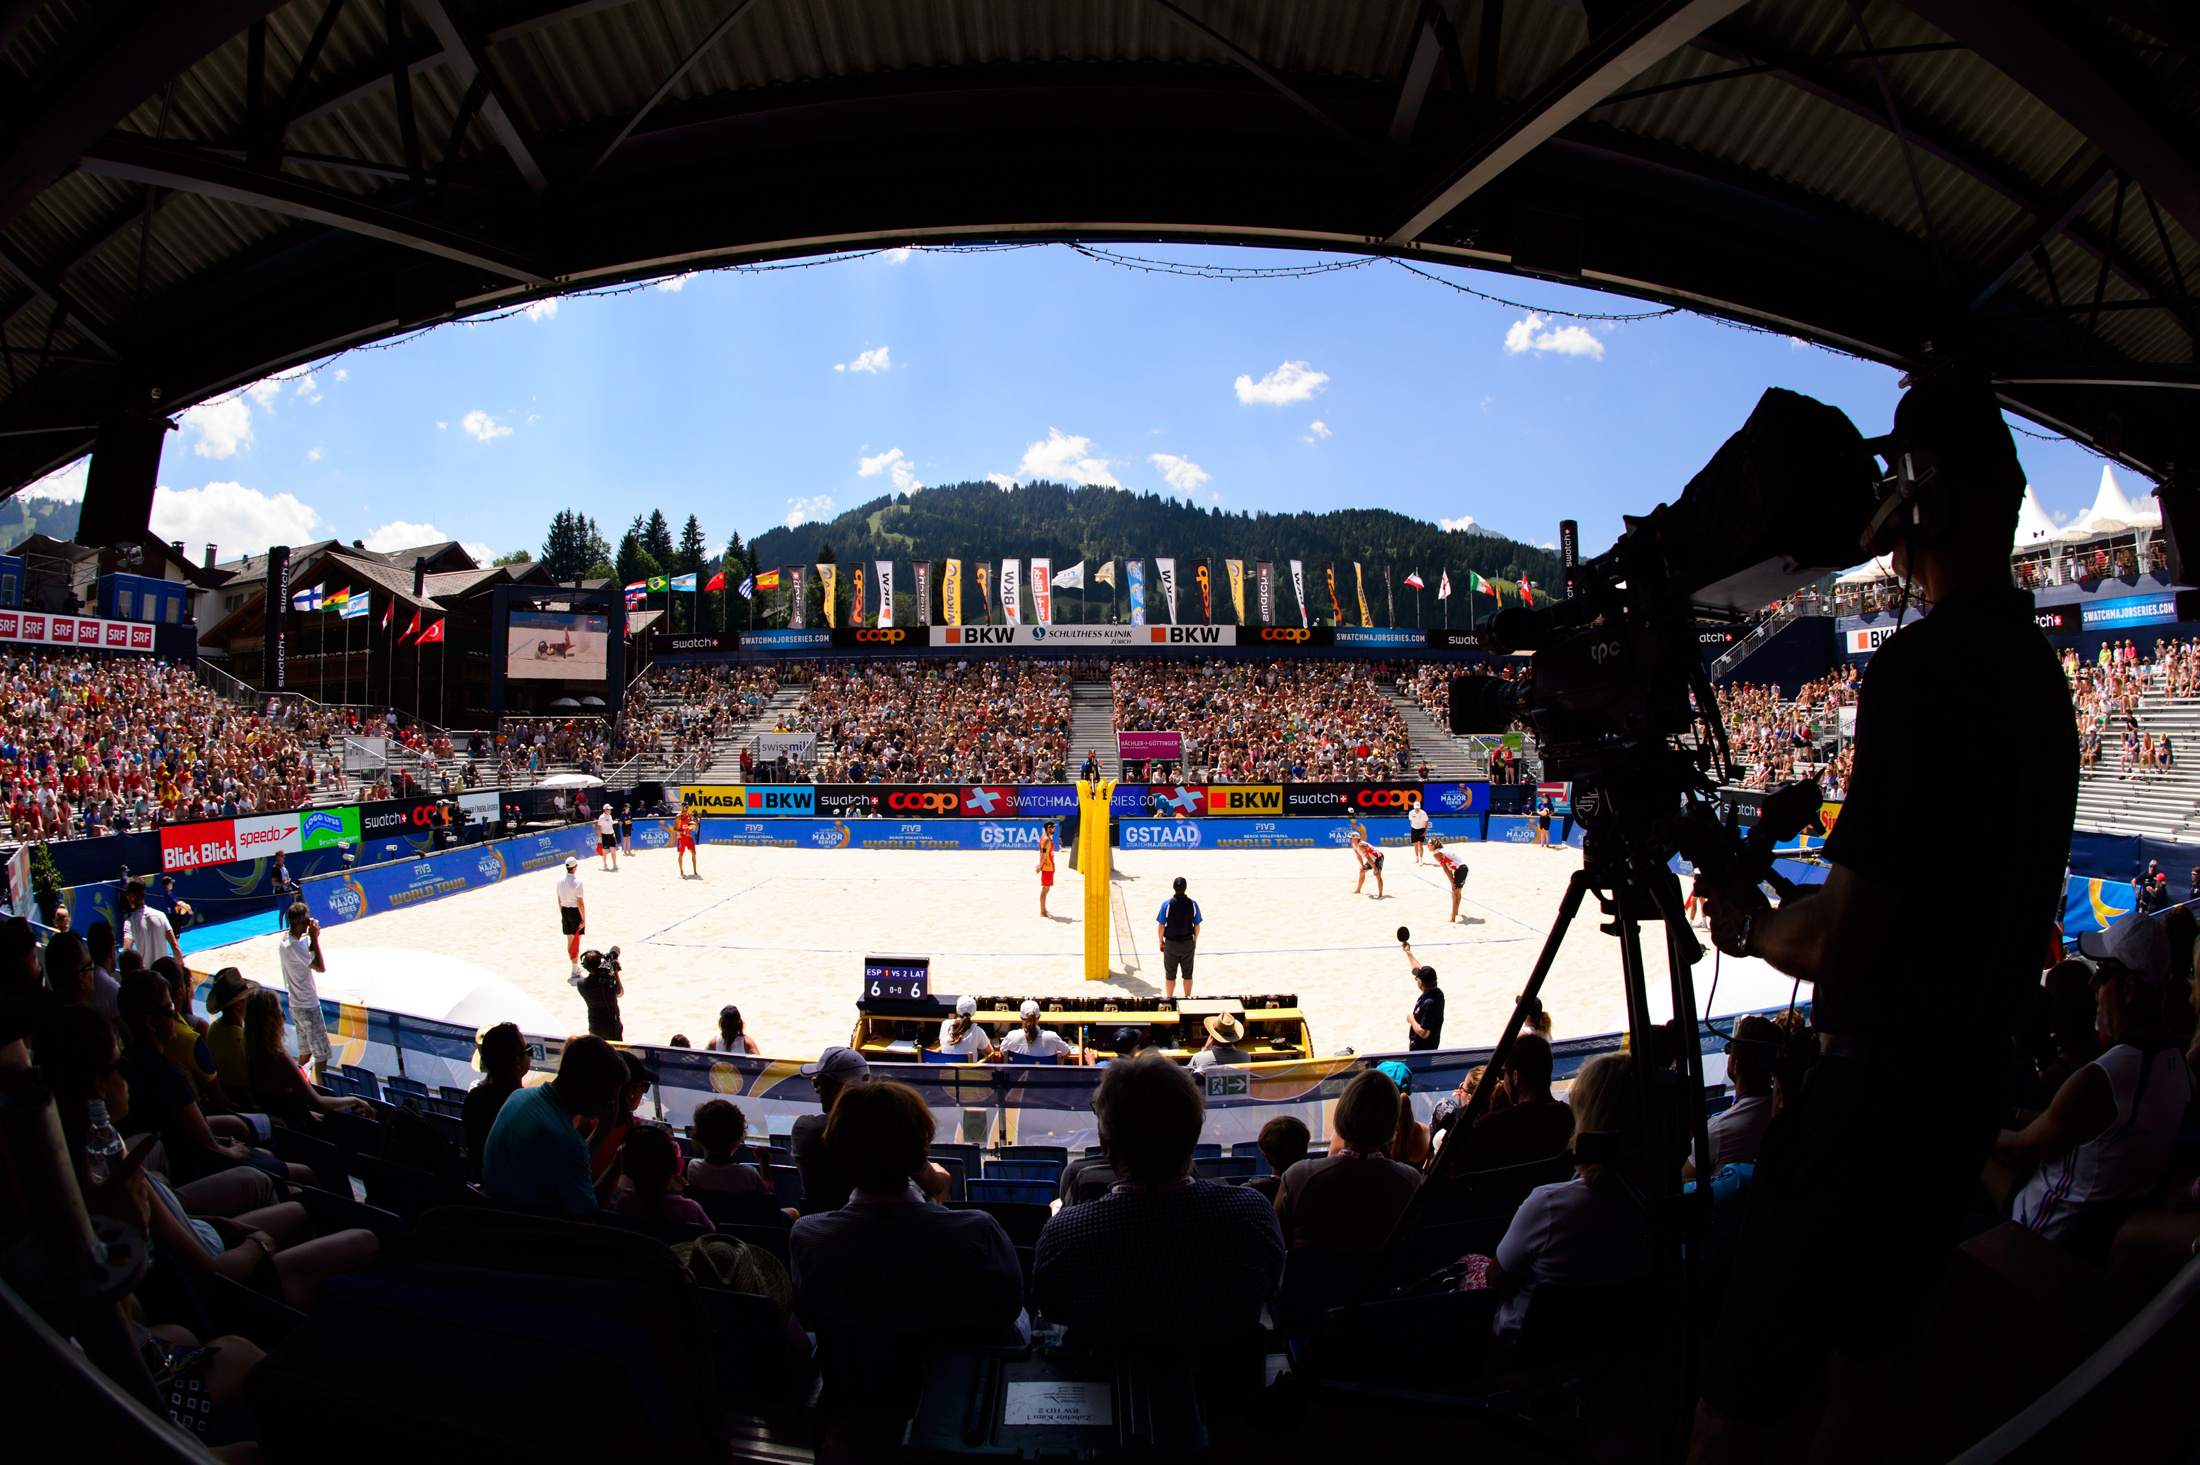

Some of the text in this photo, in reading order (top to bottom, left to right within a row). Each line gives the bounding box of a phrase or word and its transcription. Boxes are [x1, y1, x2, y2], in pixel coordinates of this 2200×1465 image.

[1564, 535, 1572, 568] swatch
[2083, 602, 2174, 622] SWATCHMAJORSERIES.COM
[24, 621, 43, 634] SRF
[54, 624, 72, 636] SRF
[80, 626, 98, 638] SRF
[1049, 630, 1132, 638] SCHULTHESS KLINIK
[108, 628, 126, 641] SRF
[133, 632, 150, 643] SRF
[741, 634, 830, 645] SWATCHMAJORSERIES.COM
[856, 629, 905, 644] coop
[964, 628, 1015, 643] BKW
[1170, 628, 1220, 643] BKW
[1261, 628, 1310, 644] coop
[1336, 633, 1425, 642] SWATCHMAJORSERIES.COM
[1699, 632, 1725, 643] atch
[672, 638, 711, 649] swatch
[766, 793, 812, 808] BKW
[821, 794, 870, 806] swatch
[888, 792, 958, 814] coop
[1230, 792, 1280, 808] BKW
[1290, 792, 1339, 804] swatch
[1357, 790, 1422, 810] coop
[305, 812, 340, 829] LOGO LYSS
[364, 812, 402, 828] swatch
[744, 824, 764, 832] FIVB
[1126, 826, 1198, 842] GSTAAD
[240, 826, 280, 848] speedo
[538, 837, 552, 846] FIVB
[710, 838, 798, 848] WORLD TOUR
[1217, 838, 1314, 848] WORLD TOUR
[862, 840, 960, 848] WORLD TOUR
[164, 840, 236, 870] Blick Blick
[522, 850, 578, 870] WORLD TOUR
[414, 863, 432, 876] FIVB
[478, 860, 502, 872] MAJOR
[389, 876, 468, 906] WORLD TOUR
[328, 894, 360, 910] MAJOR
[338, 904, 357, 915] SERIES
[871, 981, 881, 996] 6
[911, 982, 920, 998] 6
